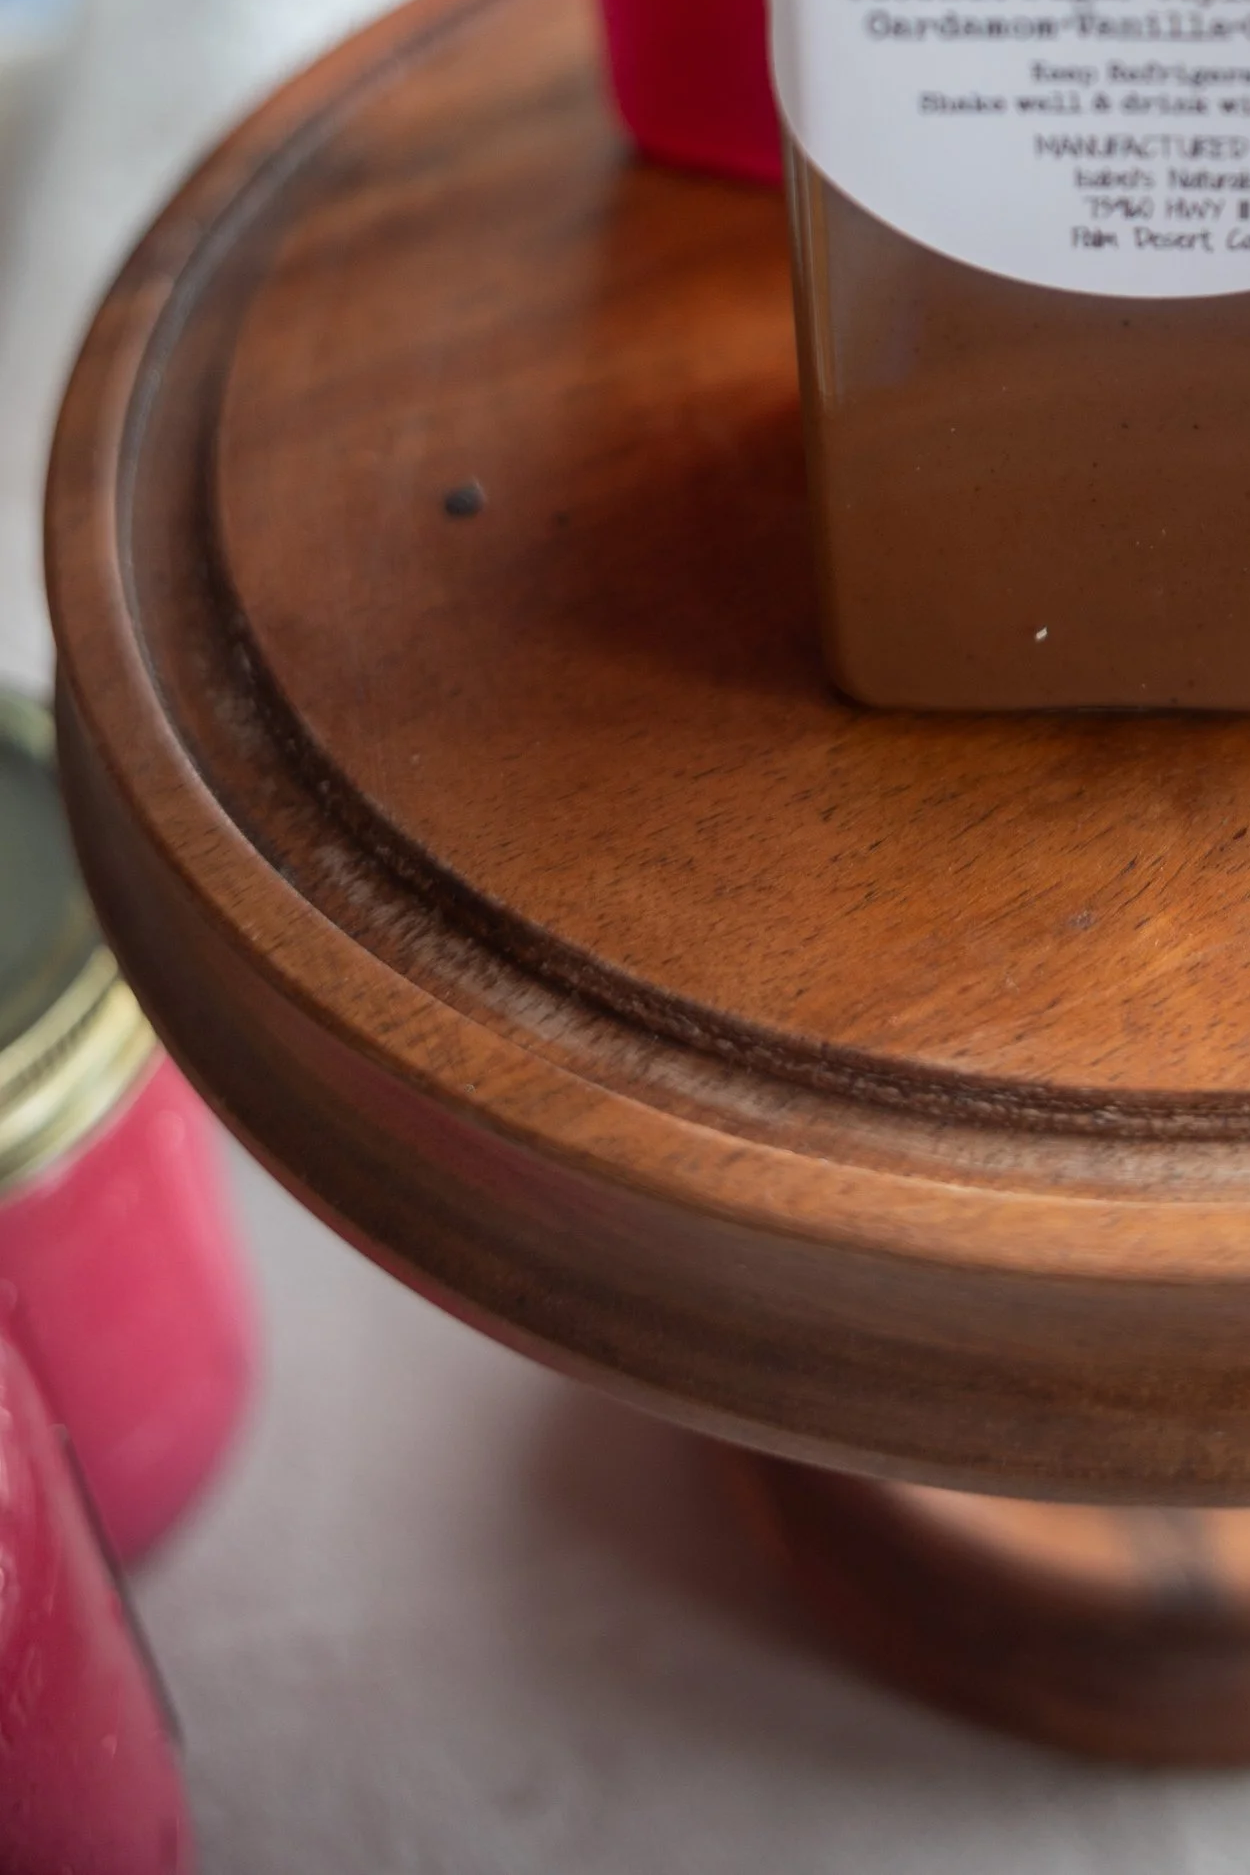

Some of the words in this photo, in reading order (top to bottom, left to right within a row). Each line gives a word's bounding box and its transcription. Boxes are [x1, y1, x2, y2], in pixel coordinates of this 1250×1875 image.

[1031, 59, 1097, 90] Keep
[918, 92, 1007, 116] Shake
[1015, 91, 1081, 116] well
[1120, 92, 1208, 117] drink
[1033, 134, 1250, 159] MANUFACTURED
[1165, 196, 1226, 222] HWY
[1071, 226, 1118, 250] Palm
[1133, 226, 1214, 253] Desert
